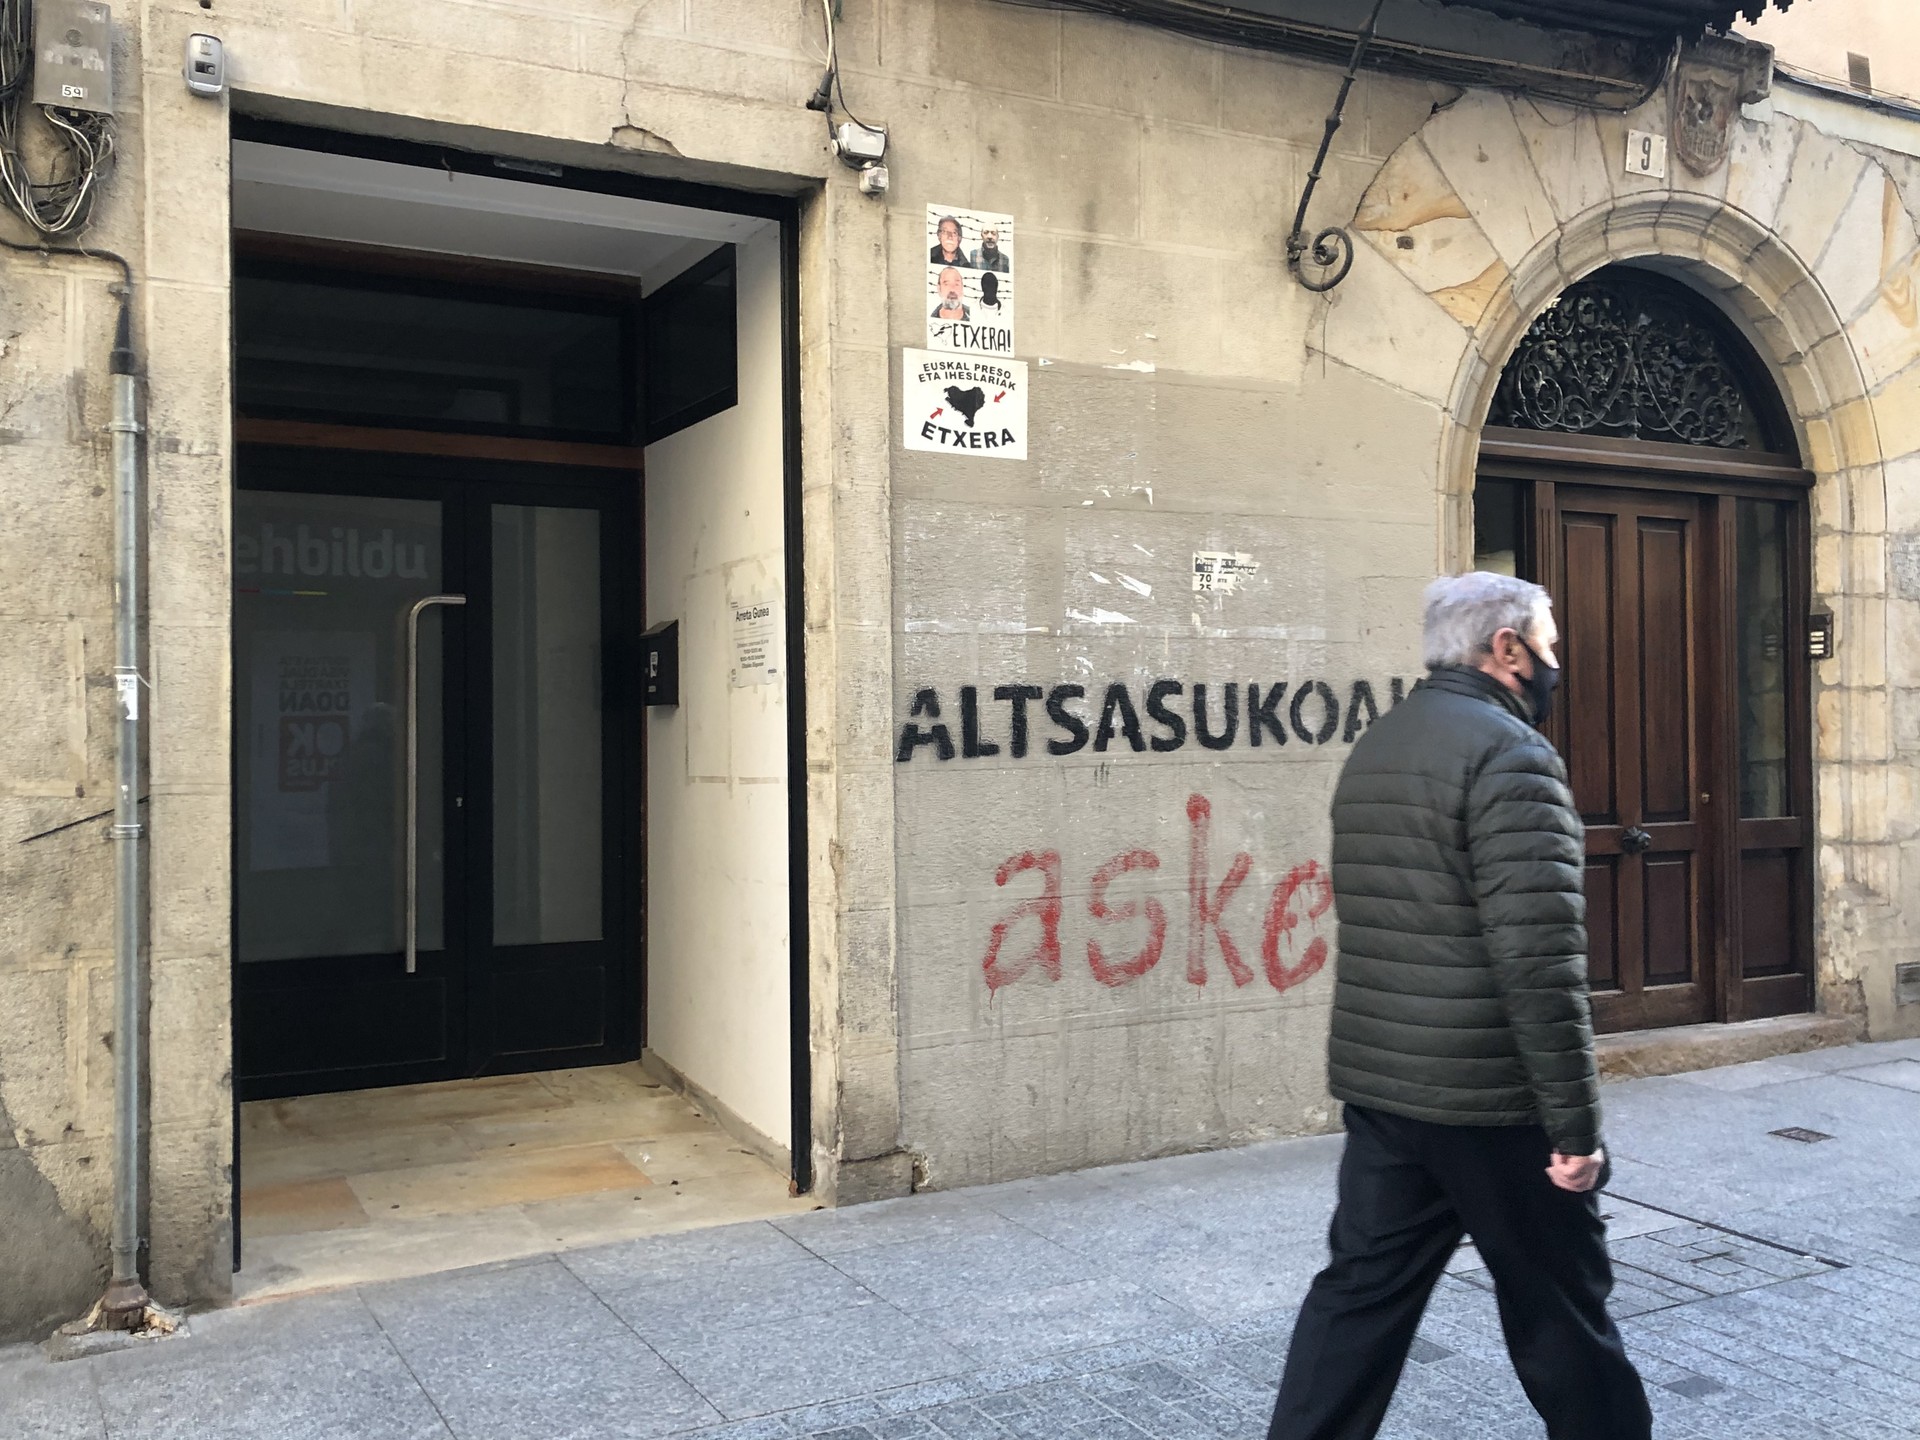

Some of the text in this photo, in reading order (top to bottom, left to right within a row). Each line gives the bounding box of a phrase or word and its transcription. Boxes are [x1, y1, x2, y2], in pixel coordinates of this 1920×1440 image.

[64, 87, 81, 95] 59
[1641, 137, 1651, 170] 9
[953, 323, 1011, 352] ETXERA!
[918, 371, 1016, 391] ETA IHESLARIAK
[923, 361, 1011, 380] EUSKAL PRESO
[921, 421, 1016, 449] ETXERA
[236, 523, 429, 579] ehbildu
[1199, 574, 1212, 582] 70
[982, 793, 1334, 1002] aske
